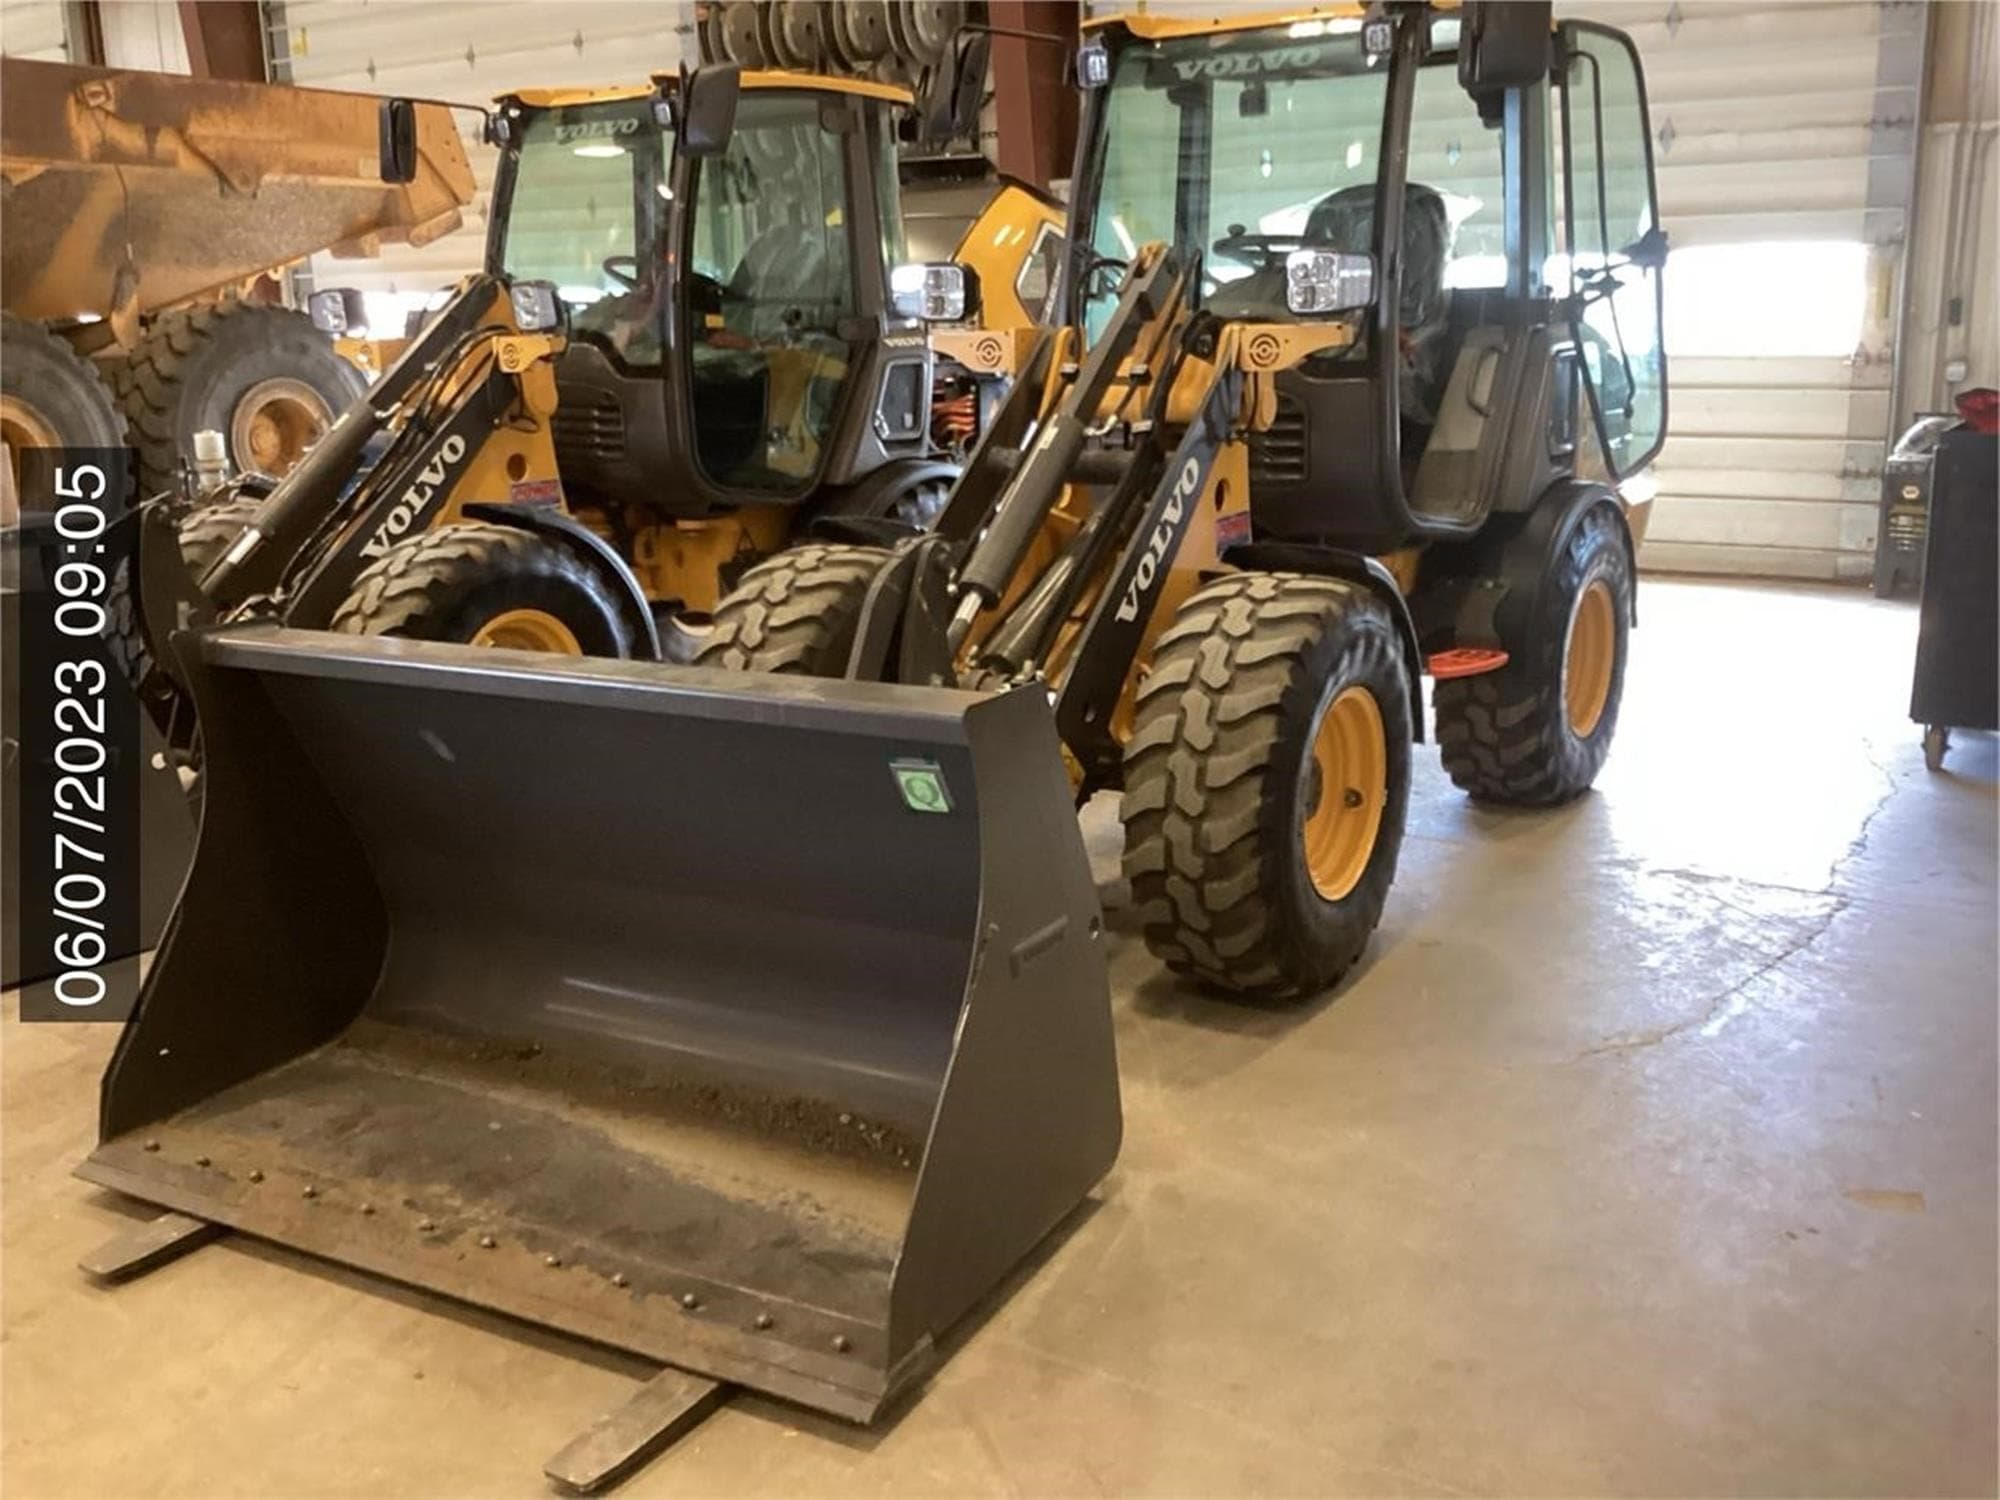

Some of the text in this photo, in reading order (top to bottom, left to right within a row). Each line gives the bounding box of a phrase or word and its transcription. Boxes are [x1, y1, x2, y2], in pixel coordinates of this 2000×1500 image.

[1173, 48, 1321, 80] VOLVO
[555, 118, 639, 140] VOLVO
[359, 434, 466, 558] VOLVO
[1115, 457, 1199, 623] VOLVO
